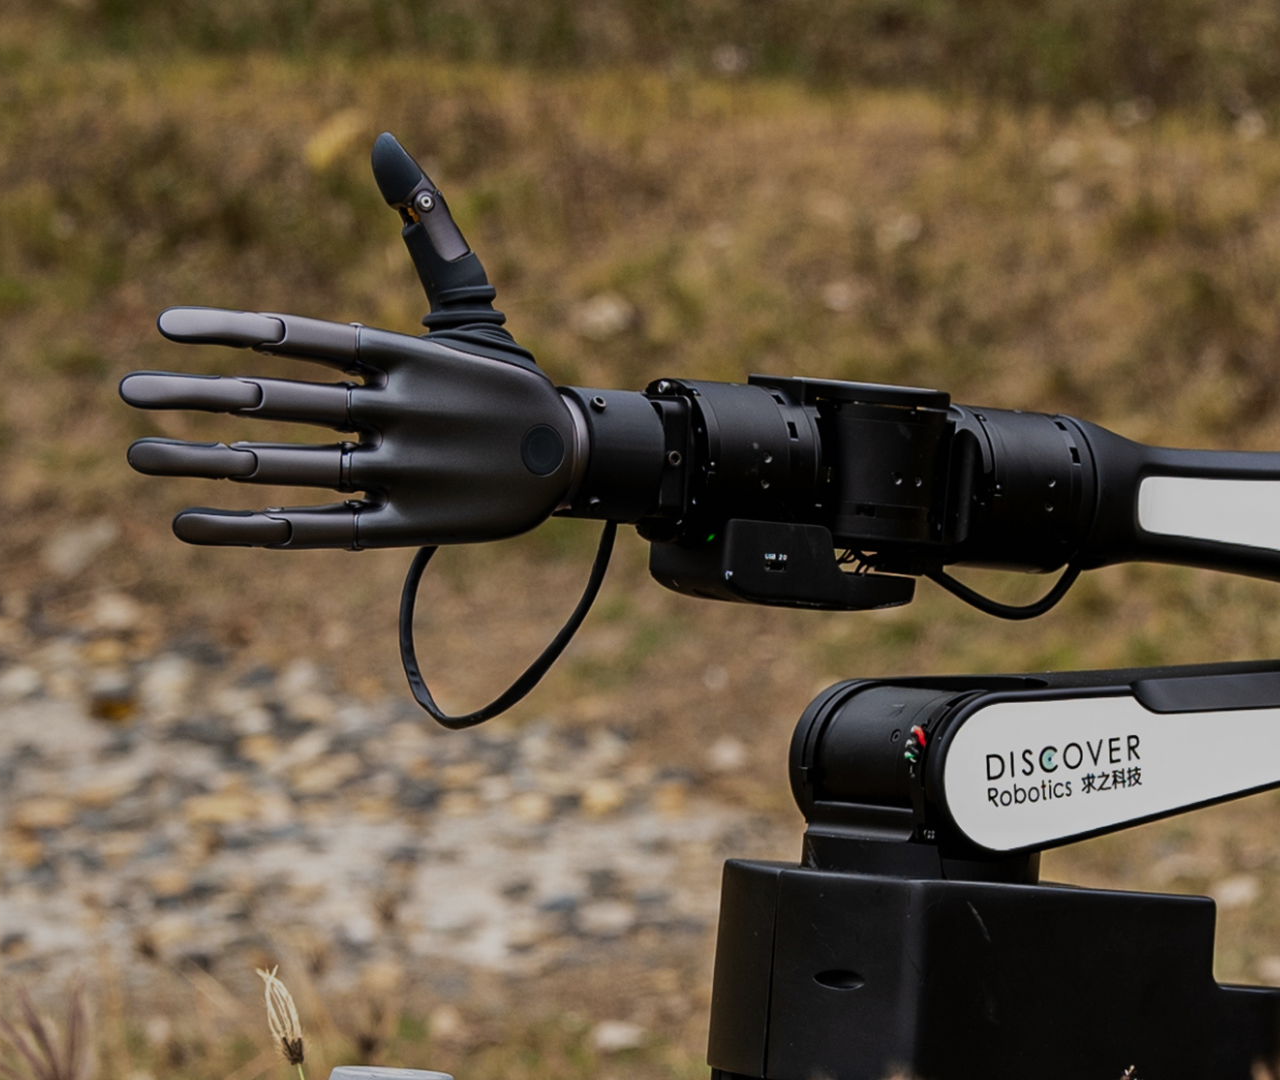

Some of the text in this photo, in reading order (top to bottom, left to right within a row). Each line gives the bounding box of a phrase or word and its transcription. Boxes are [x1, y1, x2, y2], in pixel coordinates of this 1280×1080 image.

[986, 734, 1141, 781] DISCOVER
[987, 766, 1142, 807] Robotics 求之科技
